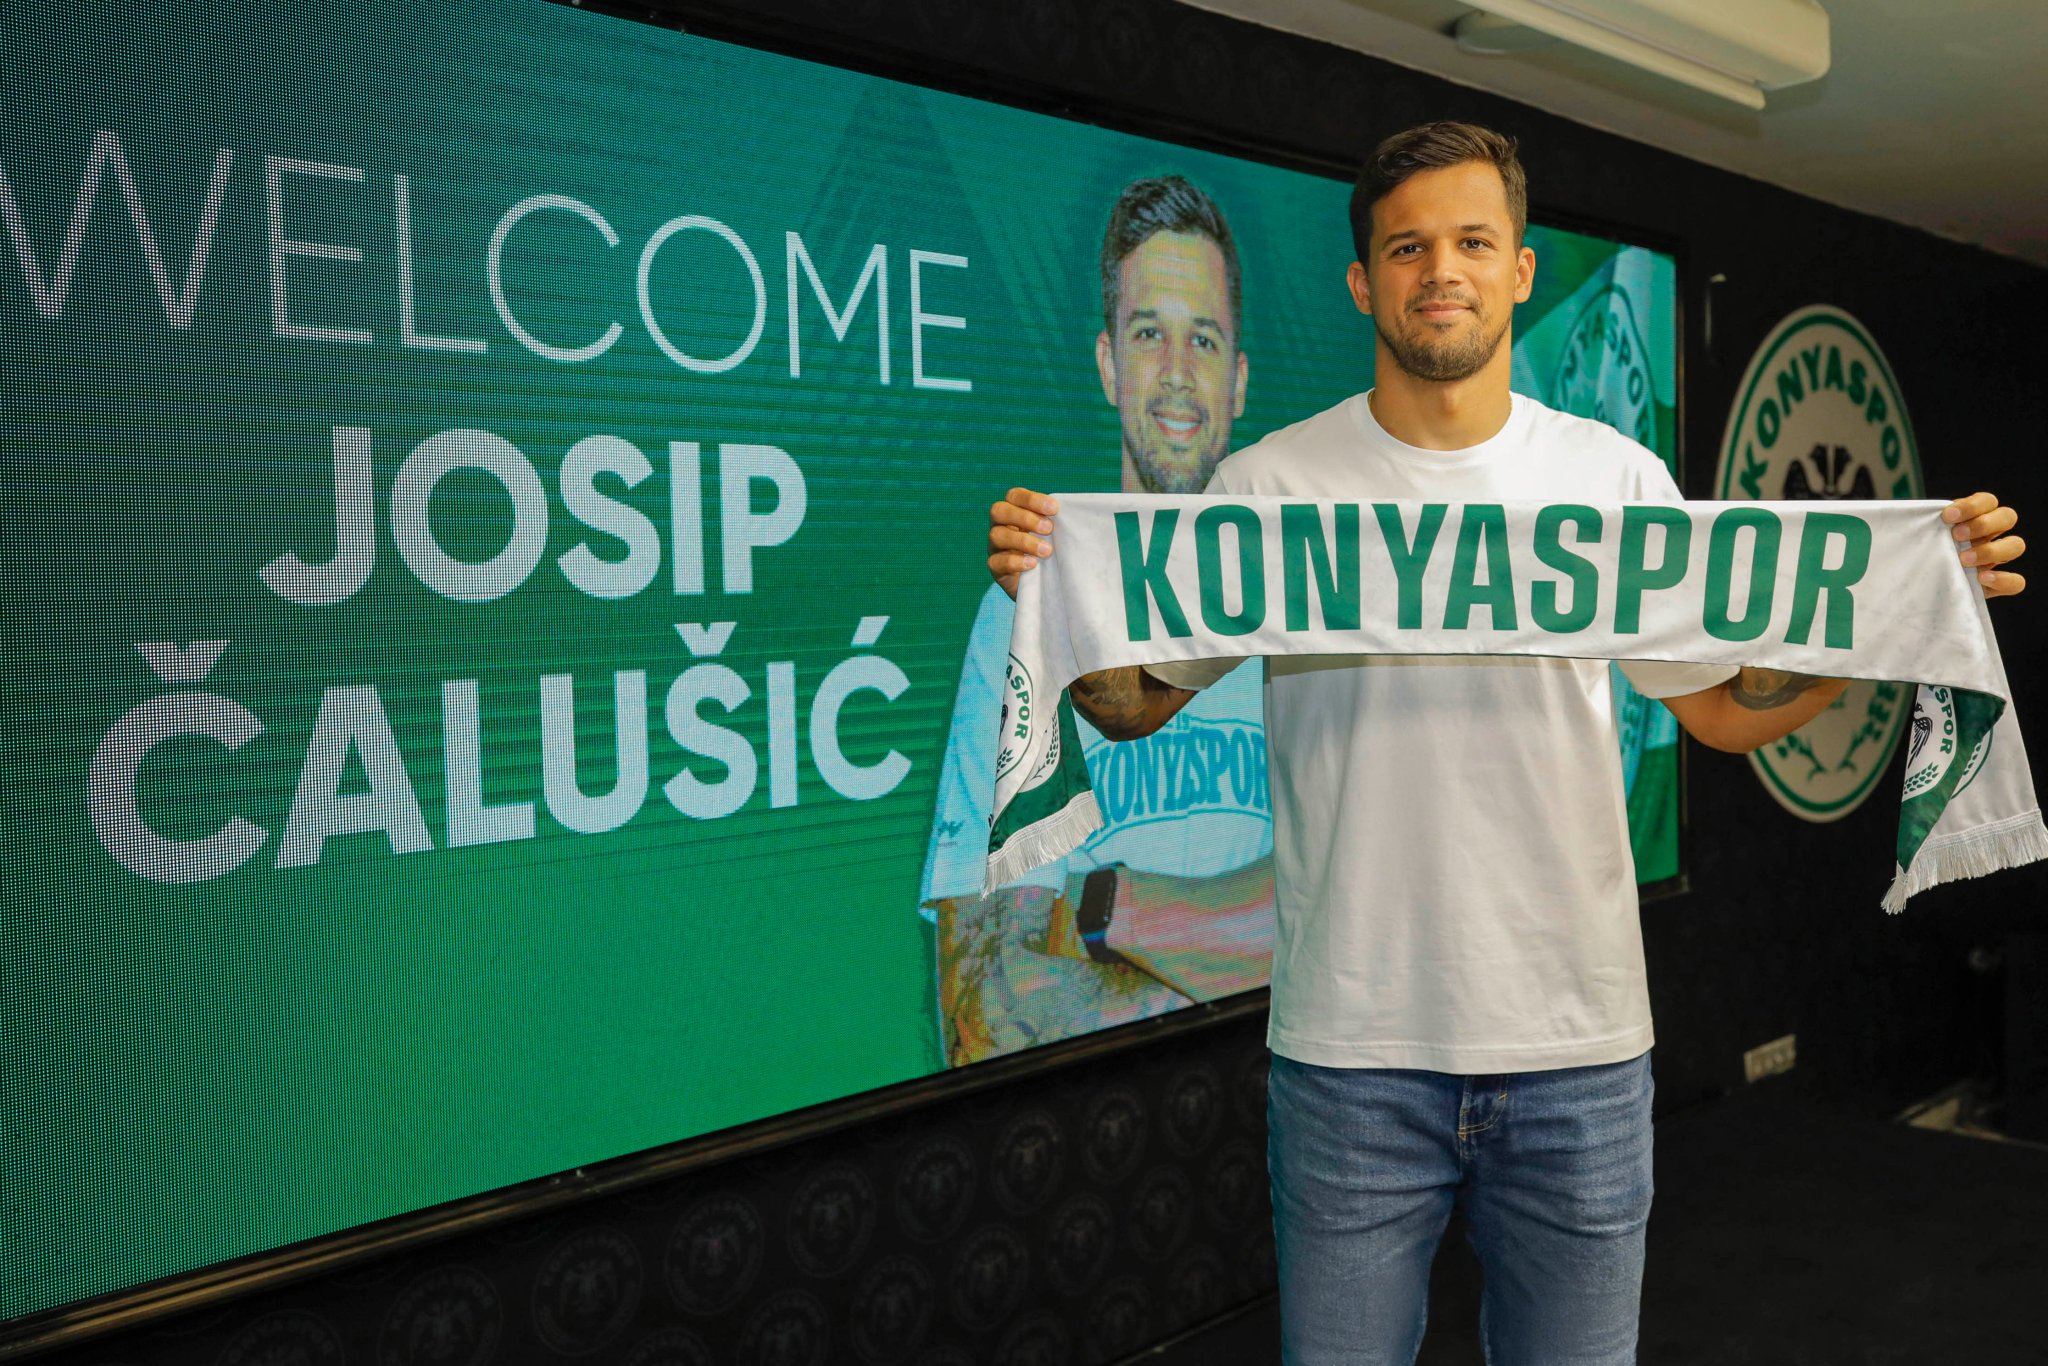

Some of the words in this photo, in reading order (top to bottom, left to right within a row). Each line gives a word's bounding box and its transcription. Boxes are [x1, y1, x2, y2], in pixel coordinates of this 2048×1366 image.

[0, 130, 973, 391] WELCOME
[259, 426, 807, 604] JOSIP
[1114, 503, 1872, 650] KONYASPOR
[87, 615, 911, 884] ČALUŠIĆ
